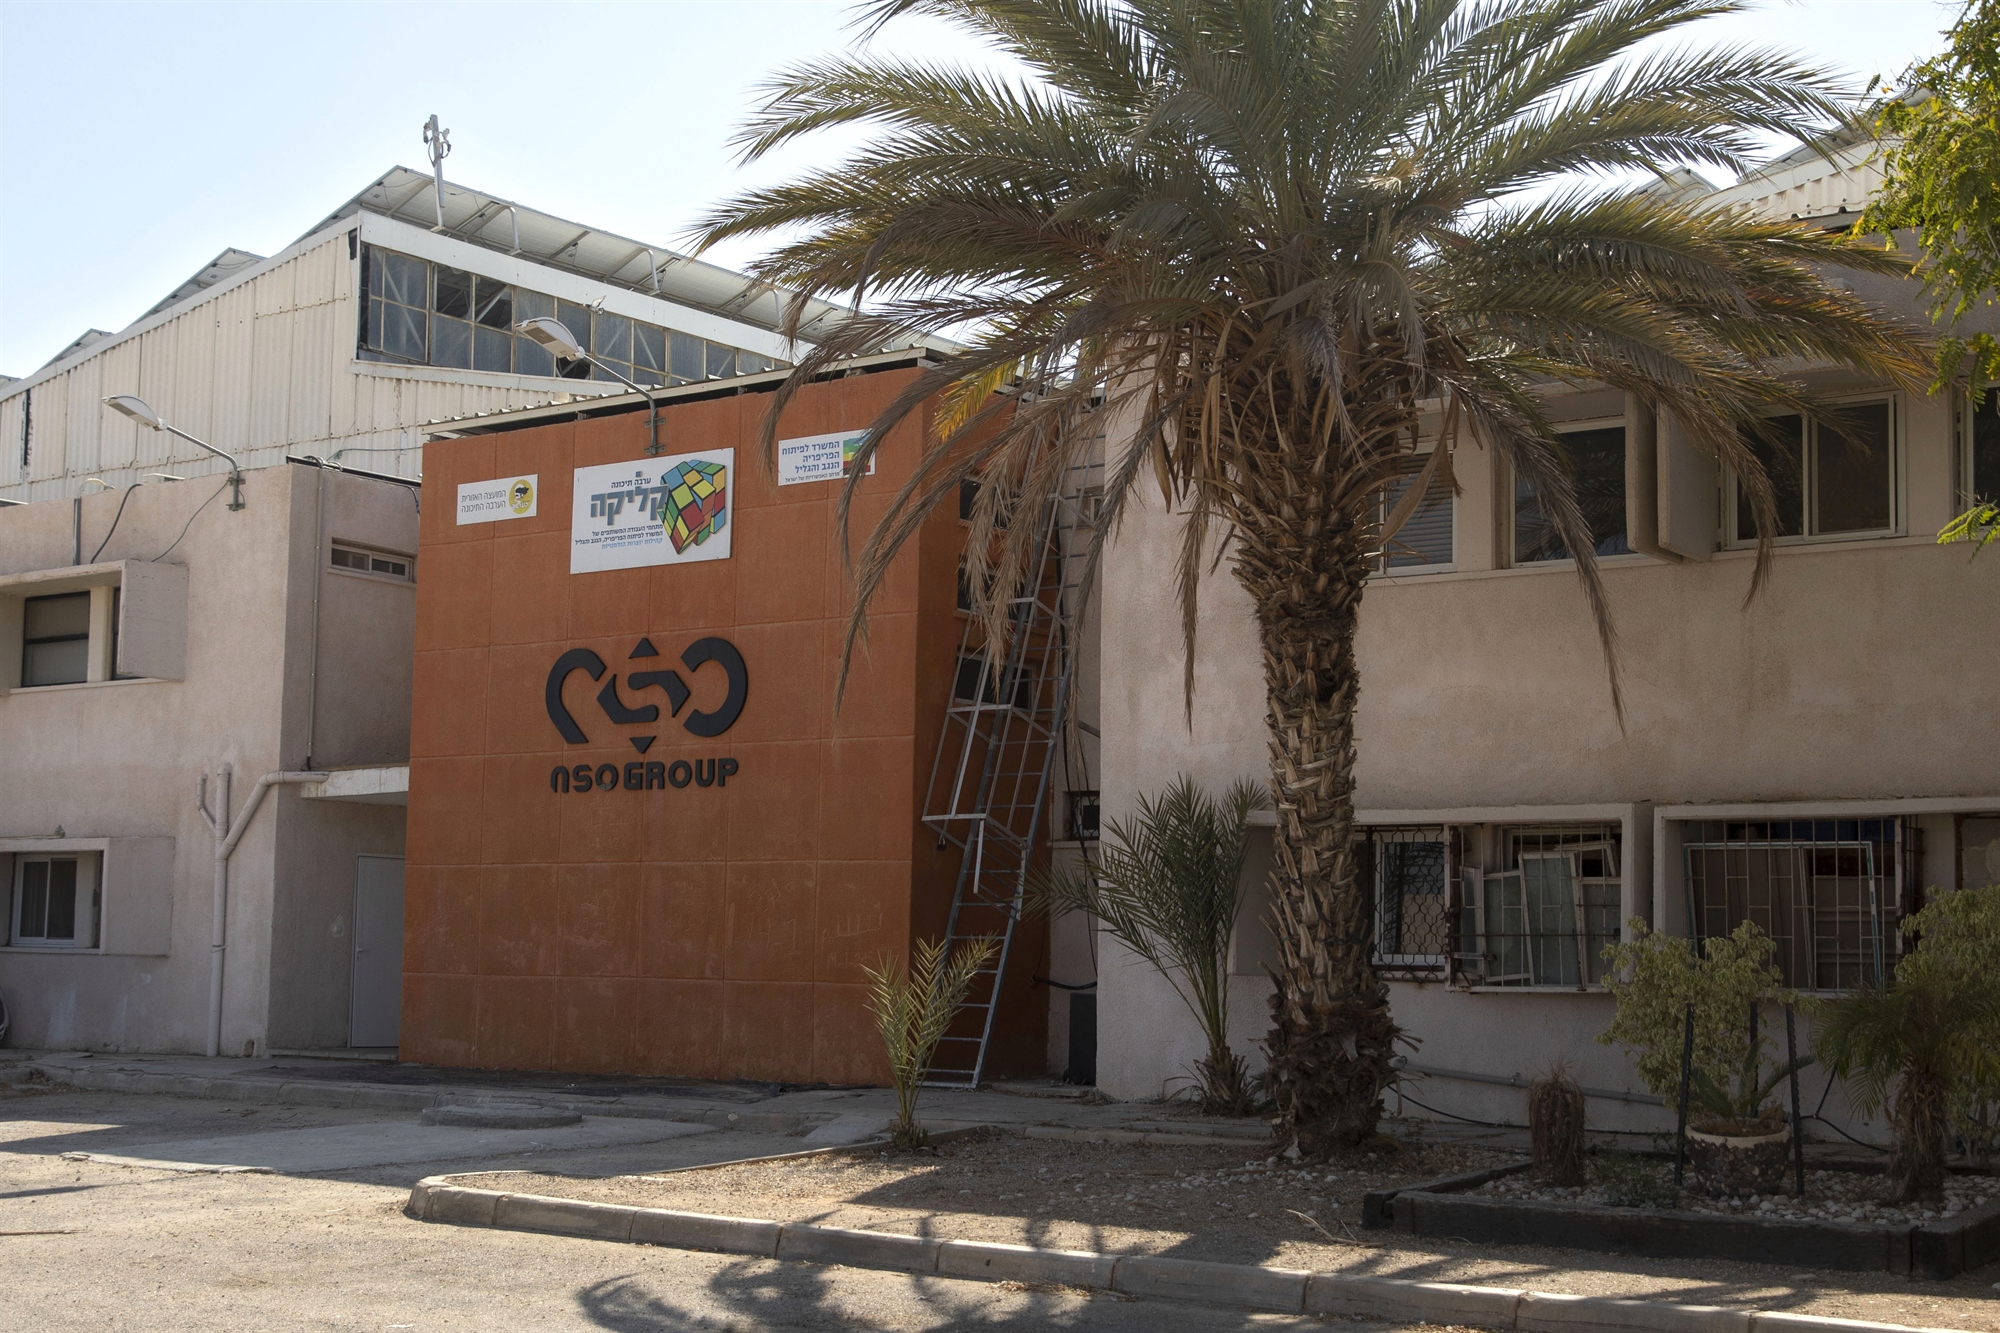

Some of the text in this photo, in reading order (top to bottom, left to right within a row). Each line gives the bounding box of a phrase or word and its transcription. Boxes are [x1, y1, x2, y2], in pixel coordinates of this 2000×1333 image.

[782, 441, 840, 455] המשרד לפיתוח
[803, 451, 840, 462] הפריפריה
[822, 461, 840, 470] הנגב
[611, 478, 652, 489] ערבה תיכונה
[484, 490, 506, 500] המועצה
[590, 471, 669, 526] קליקה
[623, 757, 739, 790] GROUP
